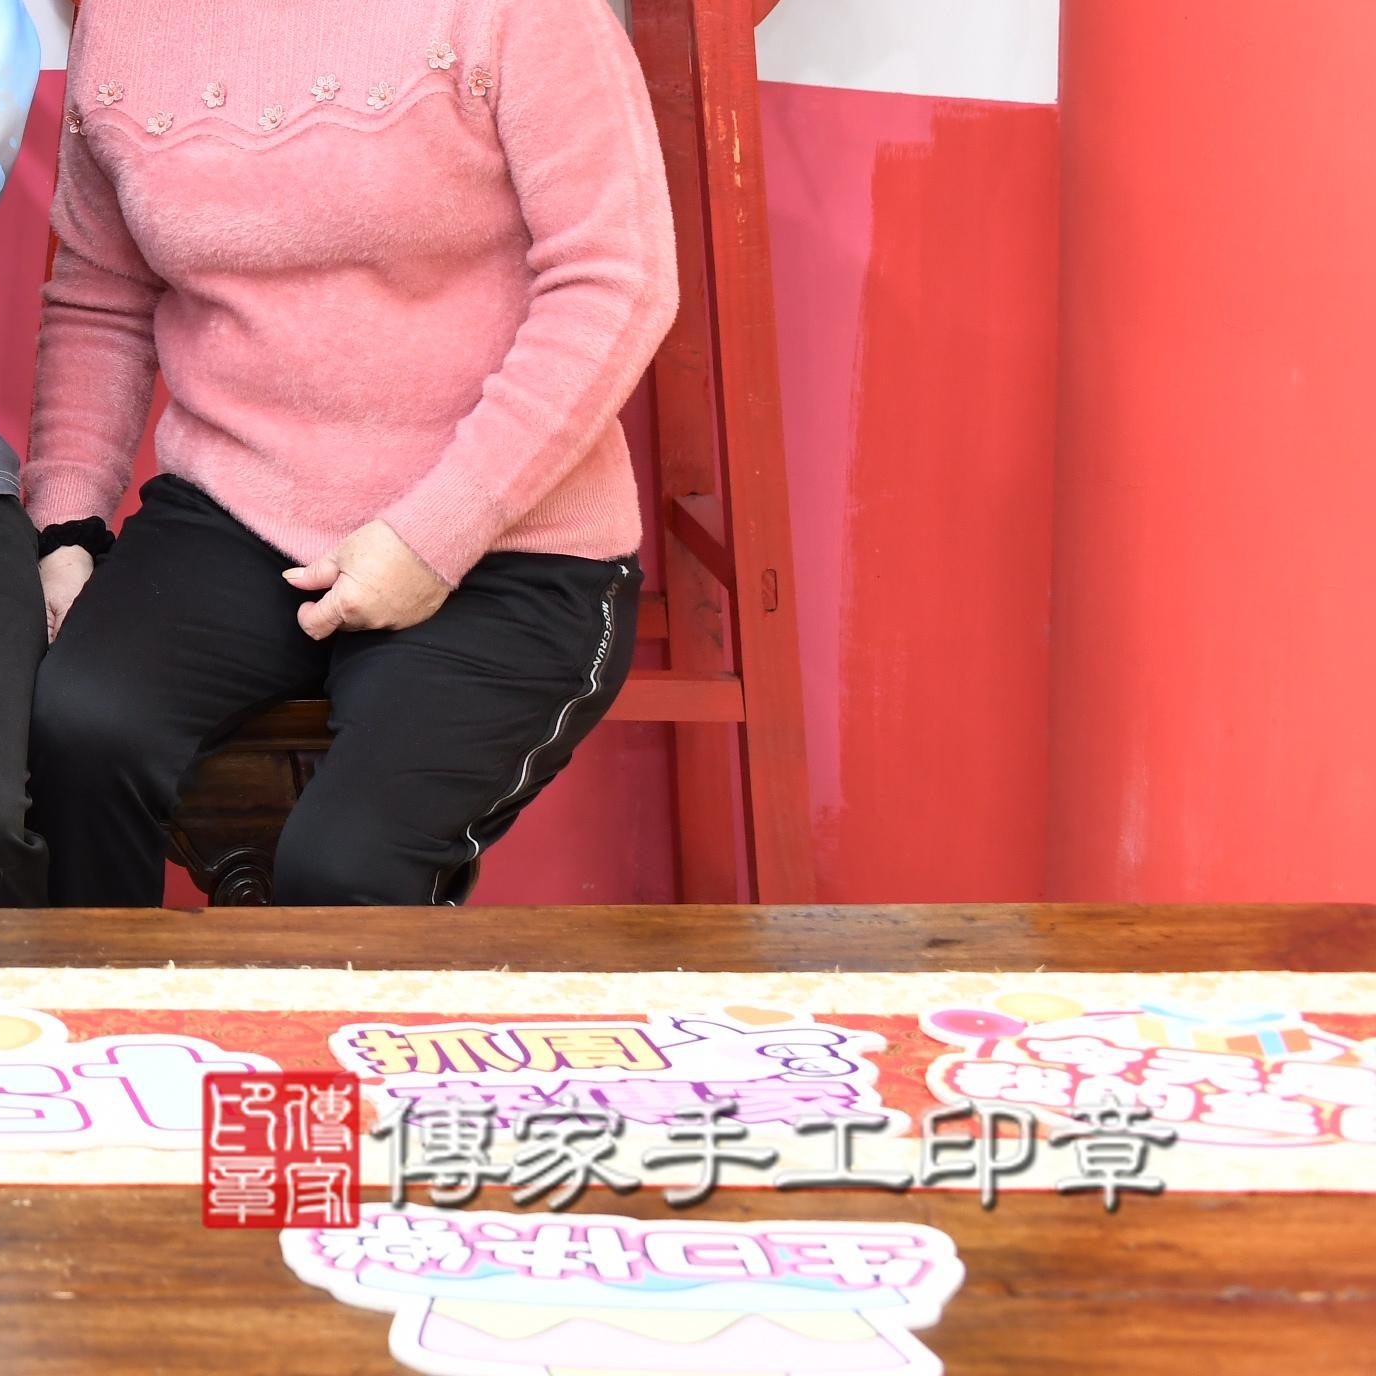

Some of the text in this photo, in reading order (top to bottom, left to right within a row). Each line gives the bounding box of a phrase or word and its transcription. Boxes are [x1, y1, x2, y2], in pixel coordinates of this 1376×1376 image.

[349, 1026, 674, 1075] 抓周
[311, 1216, 934, 1288] 生日快樂
